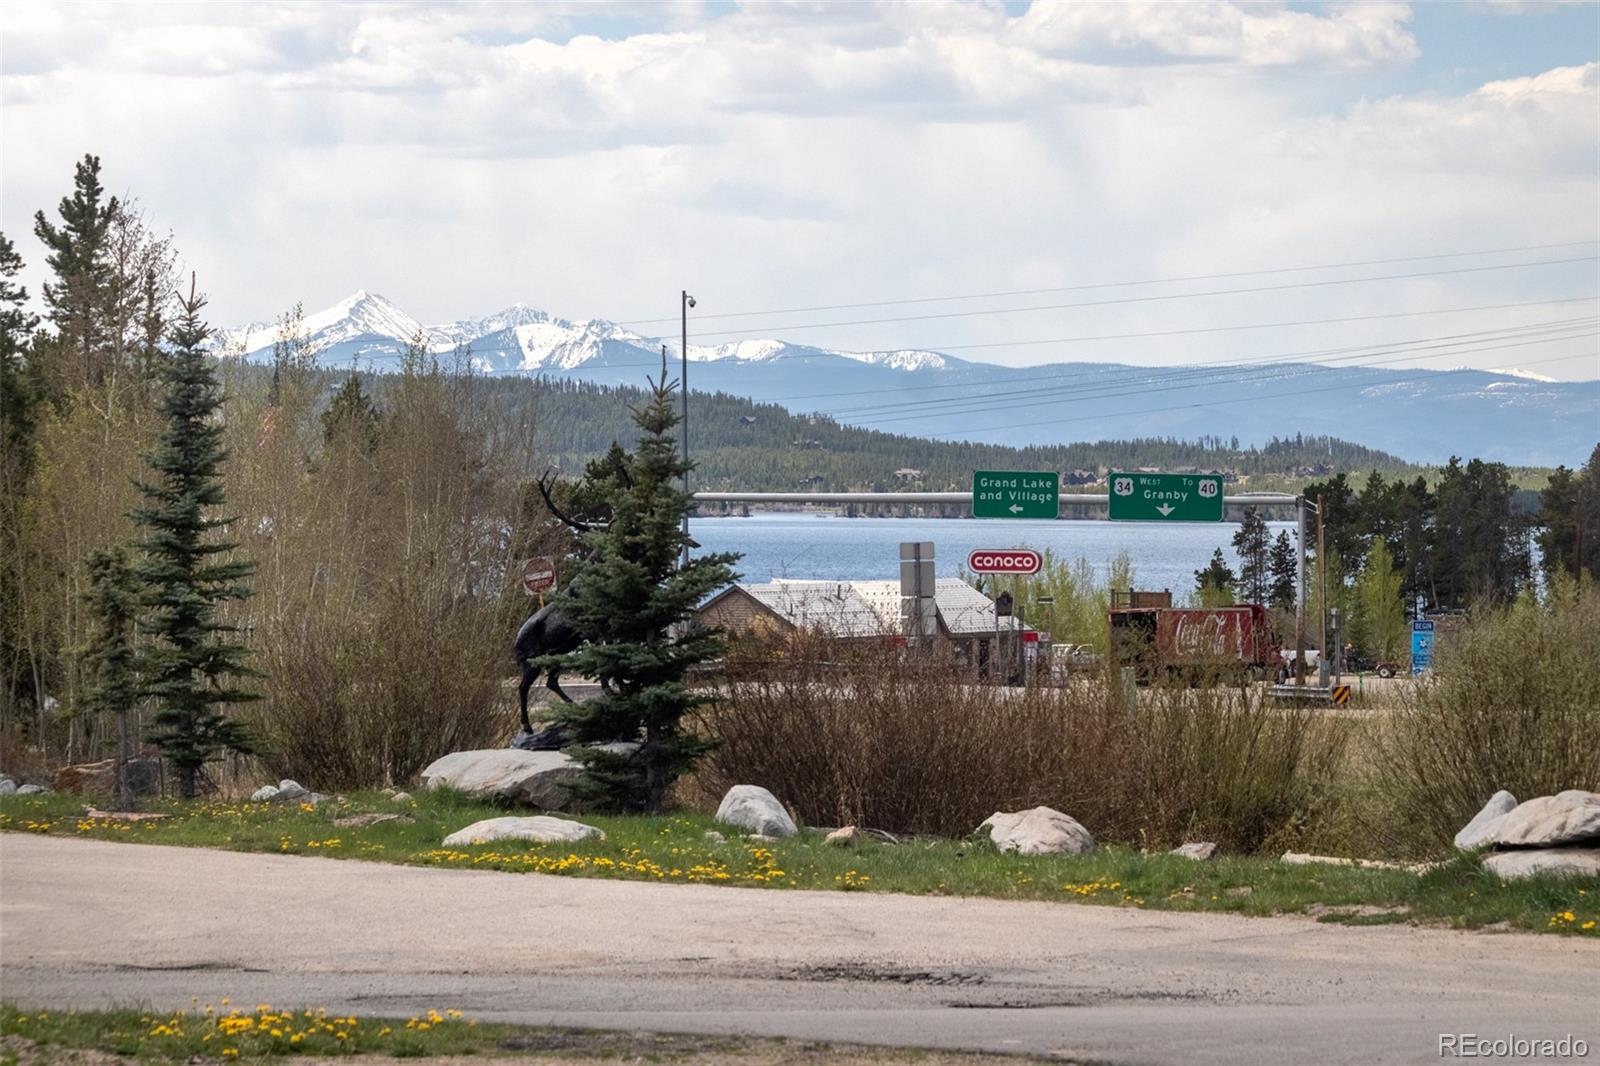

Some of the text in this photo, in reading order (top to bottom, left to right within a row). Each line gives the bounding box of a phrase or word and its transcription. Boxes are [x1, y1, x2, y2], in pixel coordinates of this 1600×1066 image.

[980, 478, 1052, 488] Grand Lake
[1117, 481, 1131, 493] 34
[1201, 482, 1216, 494] 40
[980, 491, 1053, 503] and Village
[1144, 490, 1188, 502] Granby
[1414, 622, 1432, 630] BEGIN
